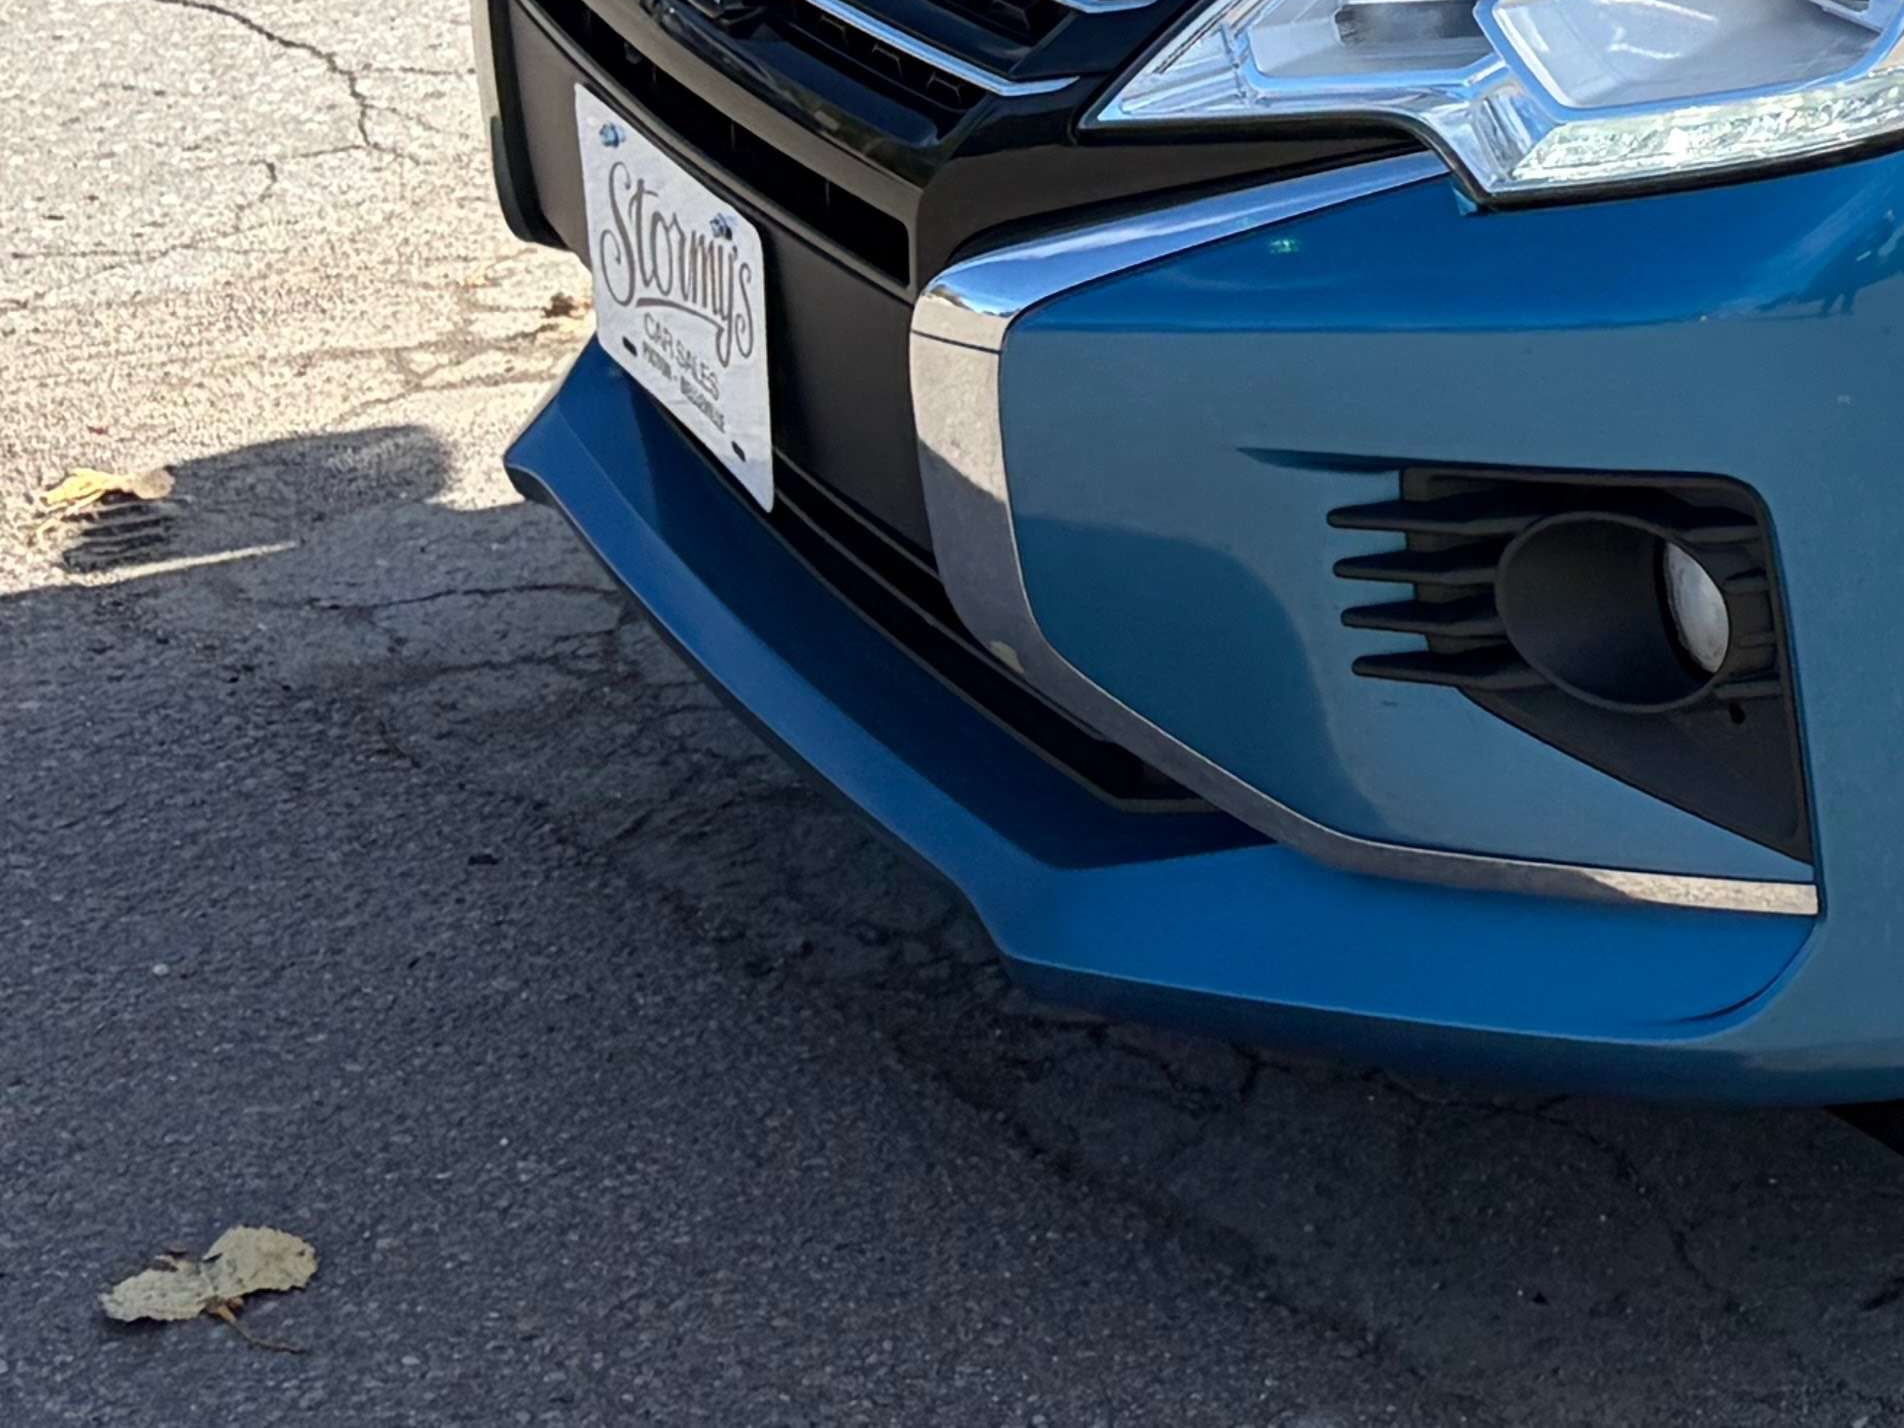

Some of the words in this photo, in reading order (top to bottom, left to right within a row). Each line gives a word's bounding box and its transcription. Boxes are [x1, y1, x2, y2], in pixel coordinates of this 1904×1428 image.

[602, 162, 754, 368] Stormy's
[644, 312, 674, 359] CAR
[675, 339, 720, 402] SALES
